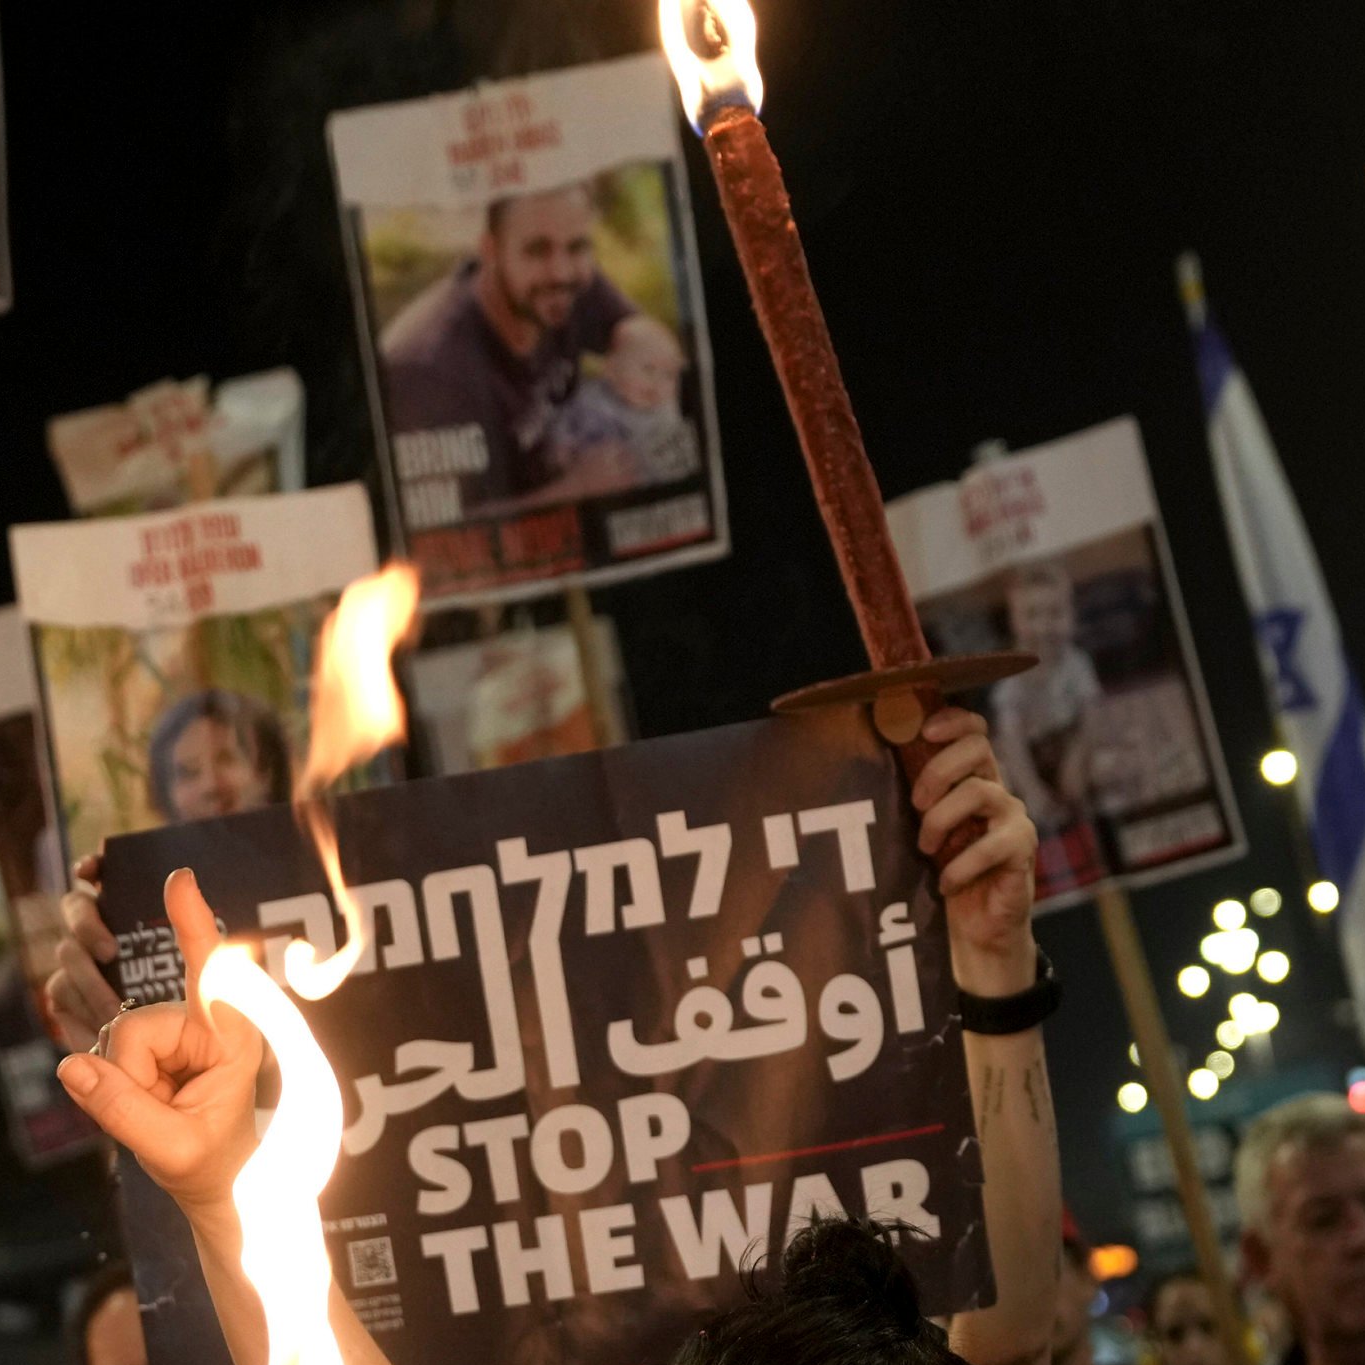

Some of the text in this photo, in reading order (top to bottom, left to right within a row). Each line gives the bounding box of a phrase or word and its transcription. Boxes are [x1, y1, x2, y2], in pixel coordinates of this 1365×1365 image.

[258, 799, 876, 1000] די למלחמה
[607, 901, 926, 1083] أوقف
[407, 1092, 692, 1216] STOP
[420, 1157, 941, 1316] THE WAR
